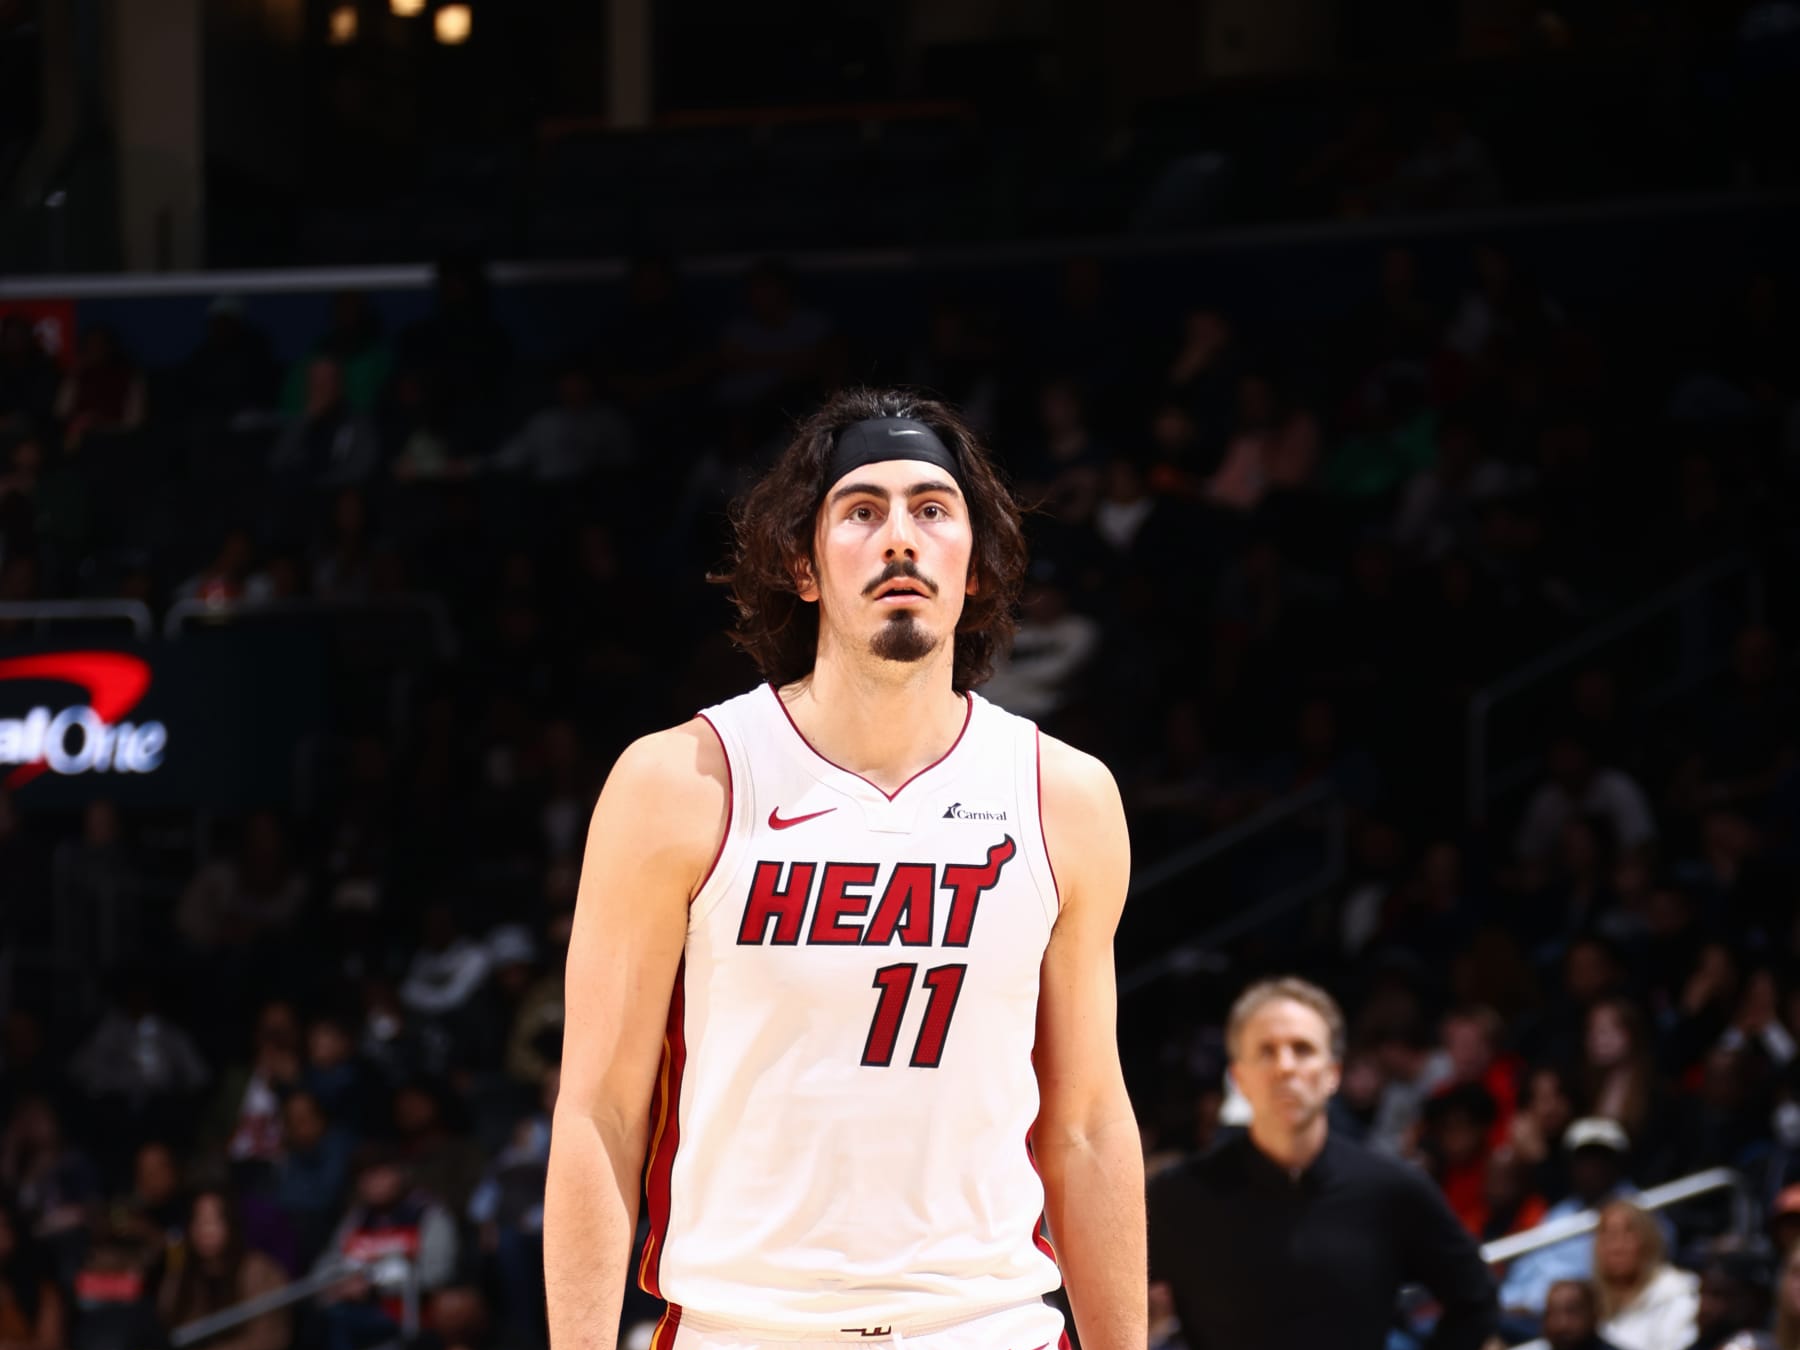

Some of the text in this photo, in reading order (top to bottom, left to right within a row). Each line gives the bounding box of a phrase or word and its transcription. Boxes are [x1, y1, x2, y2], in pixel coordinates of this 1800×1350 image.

[957, 808, 1007, 821] Carnival
[736, 833, 1016, 948] HEAT
[860, 962, 968, 1068] 11
